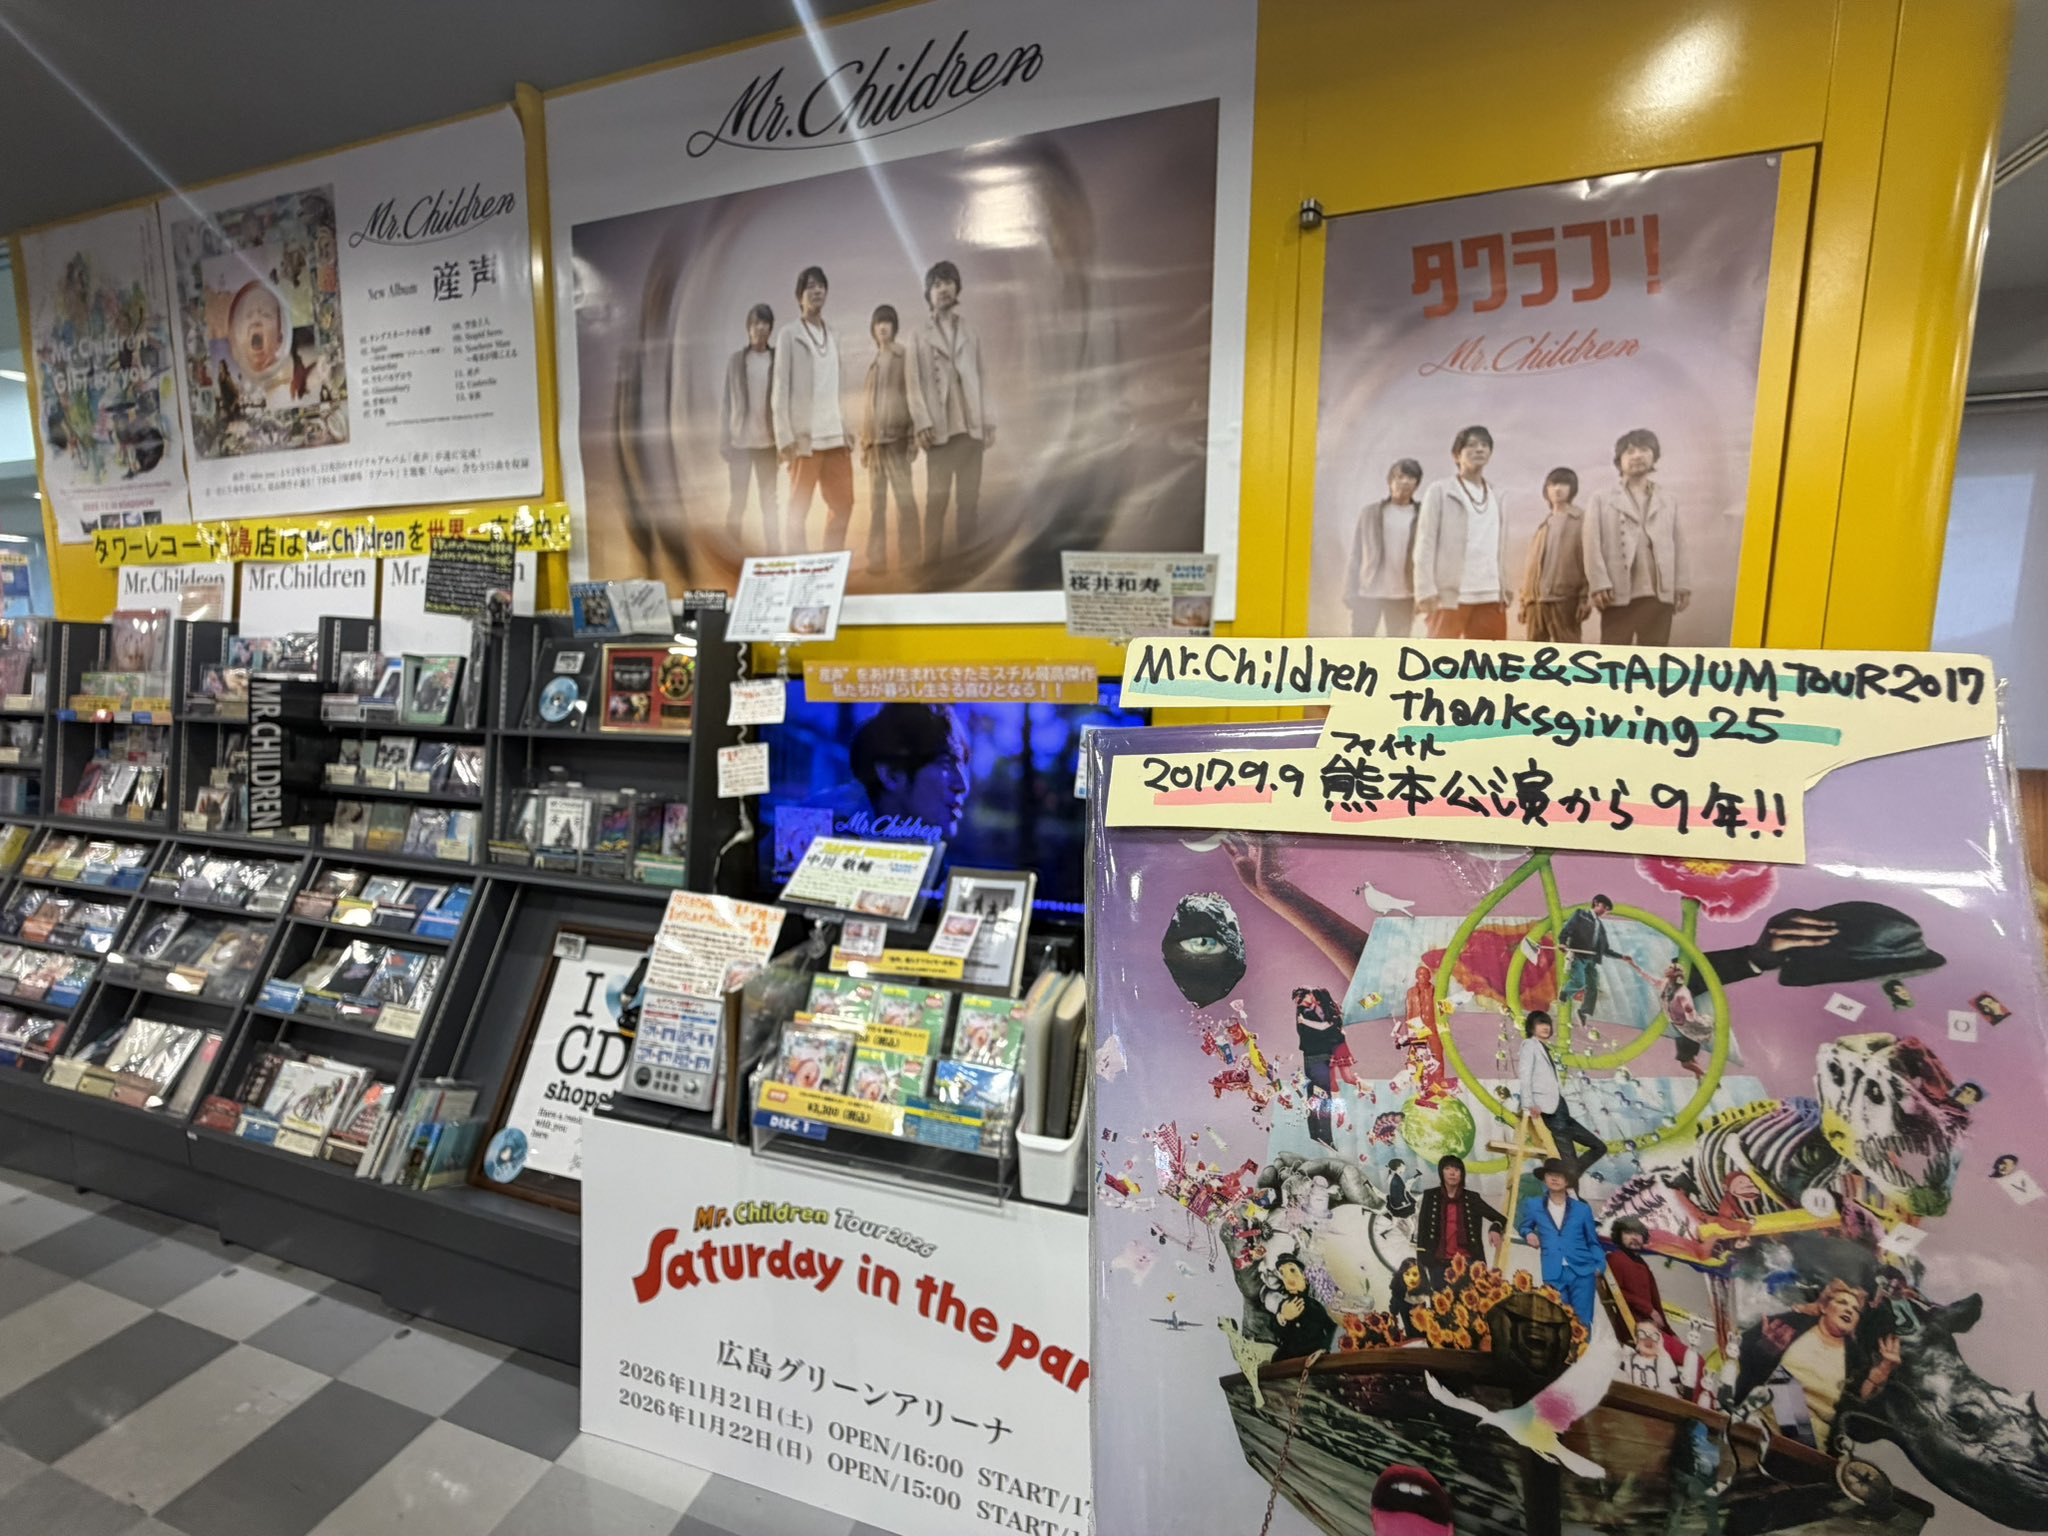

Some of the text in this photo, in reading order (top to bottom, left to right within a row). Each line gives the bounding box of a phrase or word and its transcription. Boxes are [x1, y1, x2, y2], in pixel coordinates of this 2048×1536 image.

[687, 30, 1043, 157] Mr.Children
[349, 182, 515, 248] Mr.Children
[1418, 328, 1640, 377] Mr.Children
[249, 562, 366, 592] Mr.Children
[1133, 644, 1379, 697] Mr.Children
[1391, 687, 1784, 758] Thanksgiving 25
[251, 682, 283, 830] MR.CHILDREN
[574, 971, 605, 1018] I
[555, 1024, 632, 1081] CD
[769, 1115, 799, 1131] DISC
[632, 1228, 844, 1304] Saturday
[858, 1253, 901, 1306] in
[915, 1274, 999, 1344] the
[717, 1339, 1013, 1444] 広島グリーンアリーナ
[827, 1452, 961, 1510] OPEN/15:00
[828, 1421, 963, 1478] OPEN/16:00
[977, 1467, 1090, 1517] START/1
